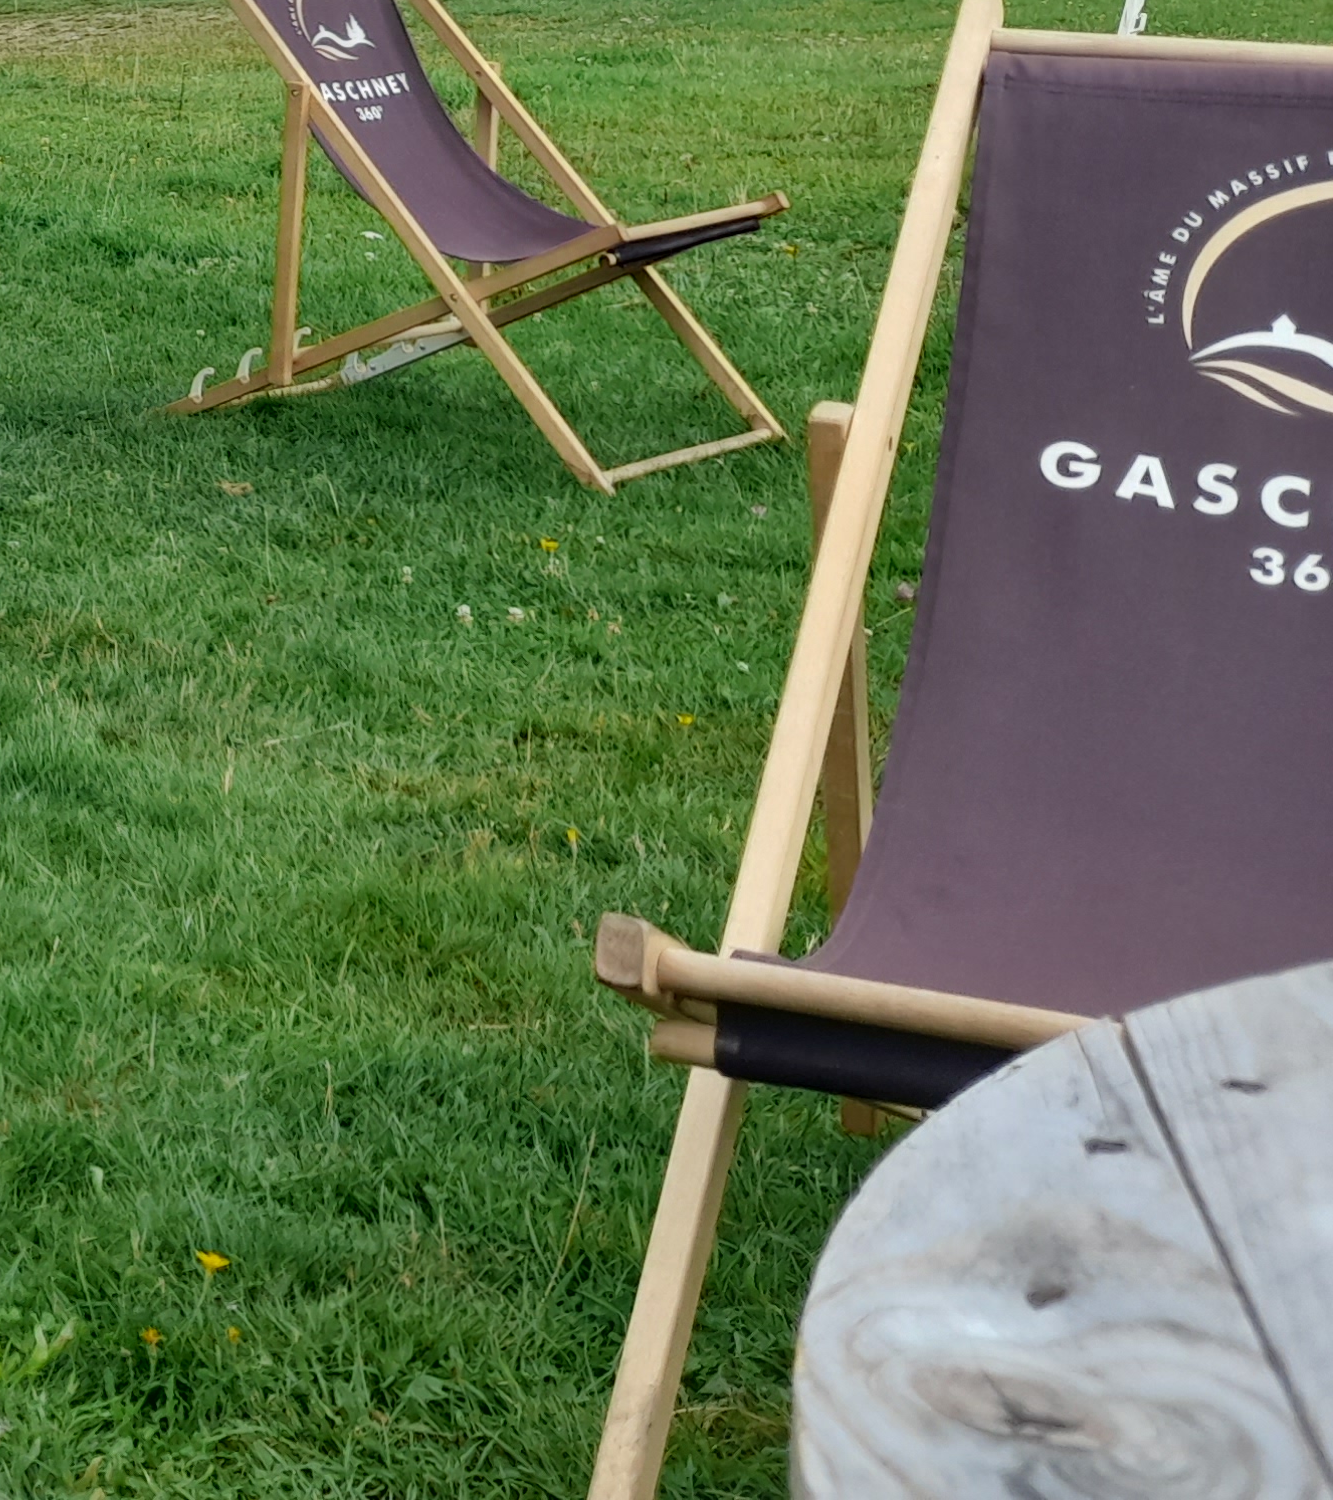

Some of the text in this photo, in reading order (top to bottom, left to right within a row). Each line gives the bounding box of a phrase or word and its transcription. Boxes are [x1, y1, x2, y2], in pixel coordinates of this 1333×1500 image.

[319, 71, 411, 102] ASCHNEY
[1171, 211, 1204, 244] DU
[1207, 154, 1310, 210] MASSIF
[1040, 440, 1312, 528] GASC
[1249, 547, 1331, 592] 36
